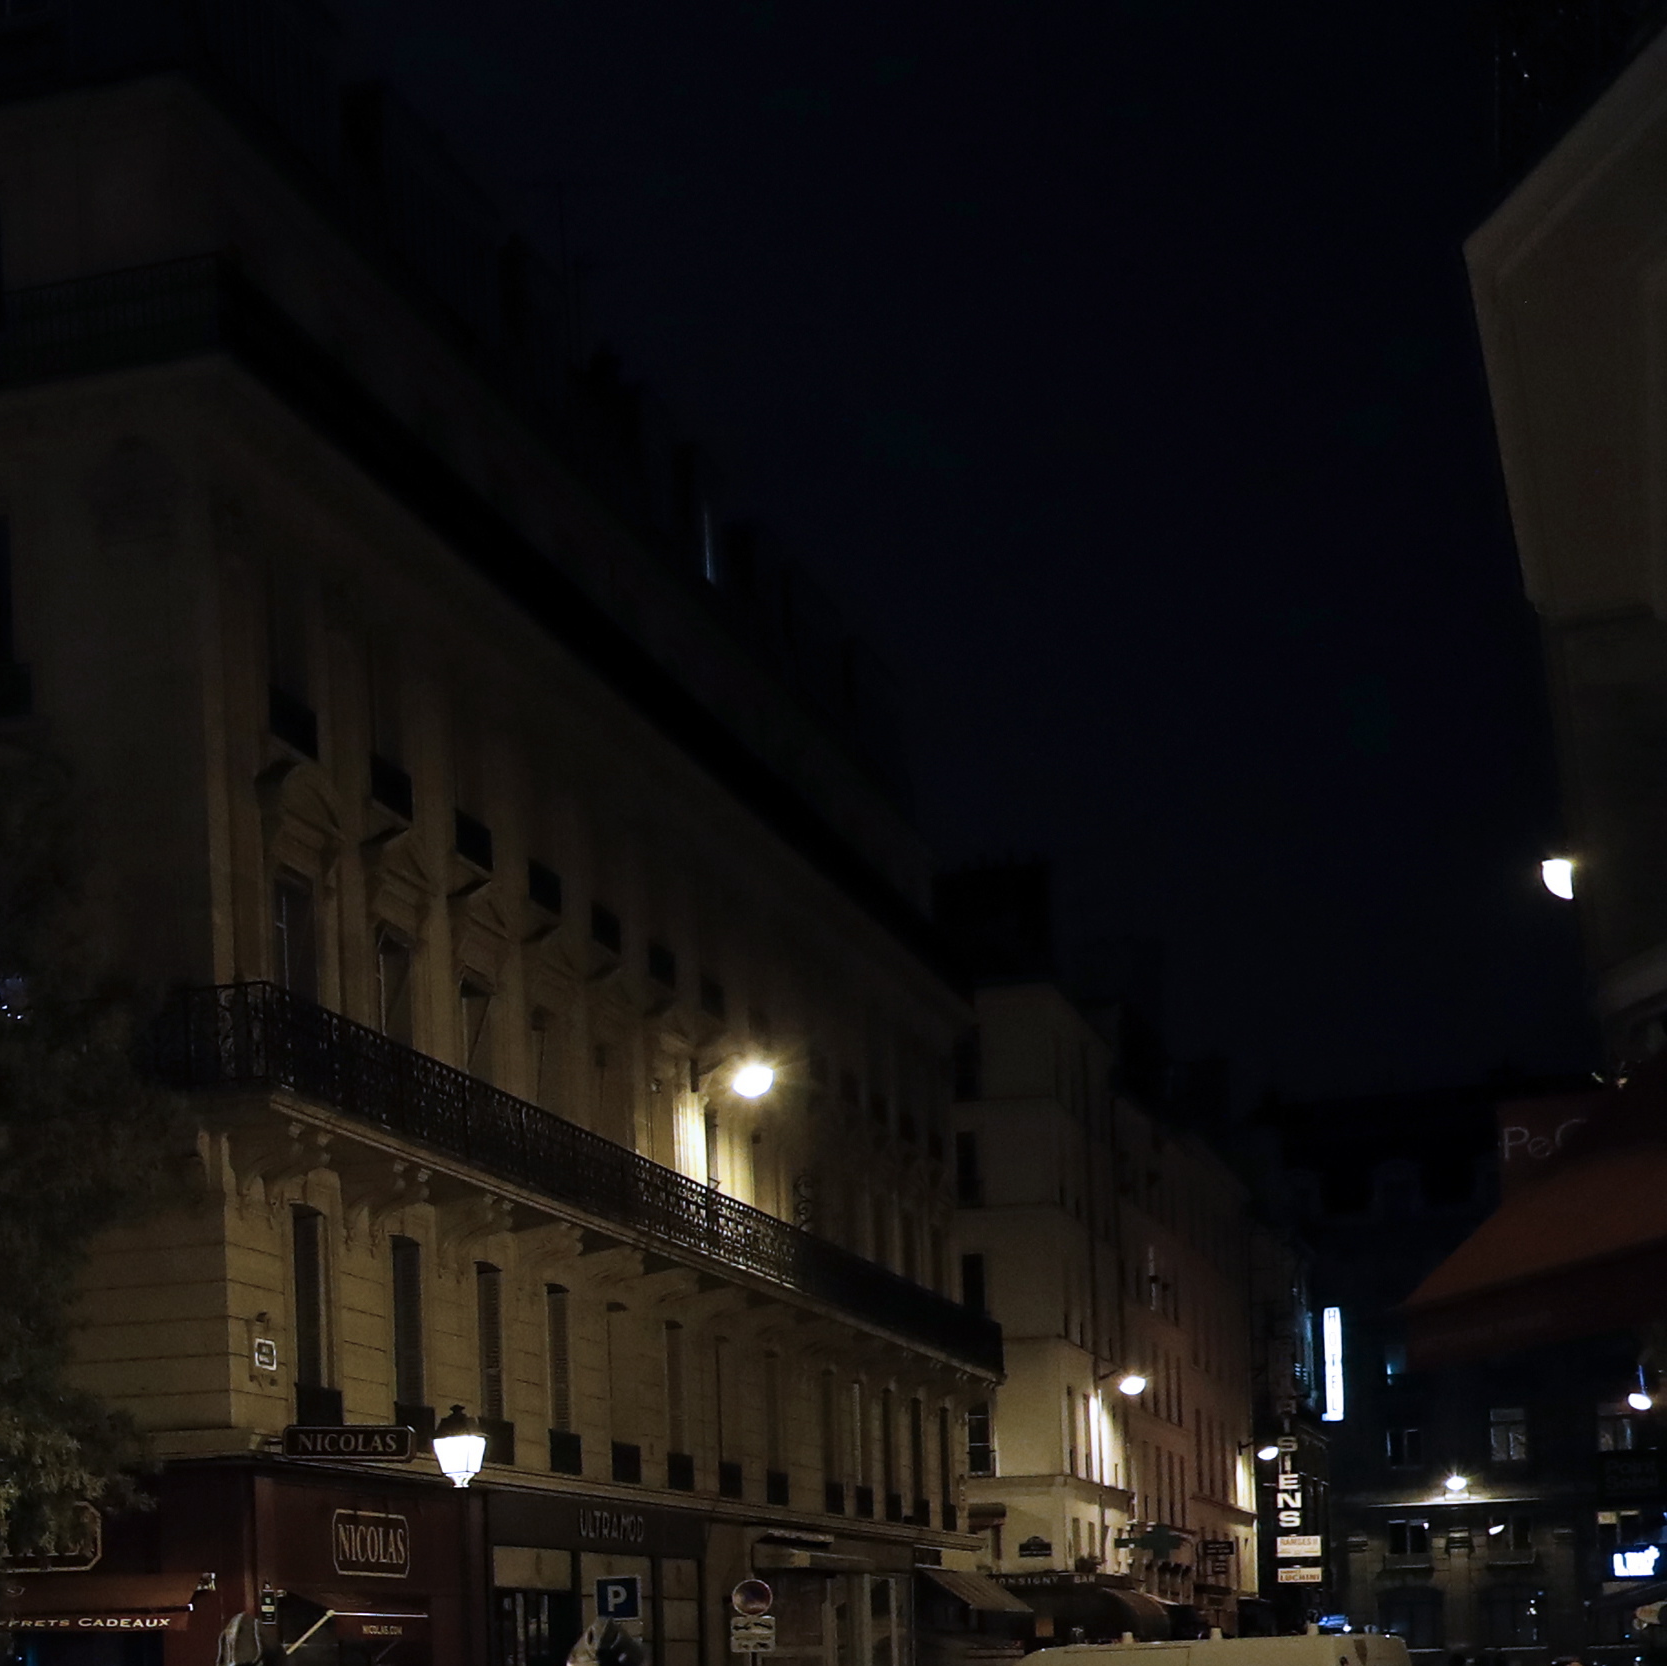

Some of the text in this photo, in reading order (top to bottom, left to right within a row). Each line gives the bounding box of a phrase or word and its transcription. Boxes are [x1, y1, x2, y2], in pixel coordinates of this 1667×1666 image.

[1327, 1309, 1338, 1411] HOTEL
[298, 1433, 397, 1452] NICOLAS
[579, 1508, 644, 1543] ULTRAMOD
[338, 1523, 406, 1565] NICOLAS
[1073, 1575, 1096, 1584] BAR
[606, 1584, 628, 1613] P
[77, 1617, 172, 1629] CADEAUX
